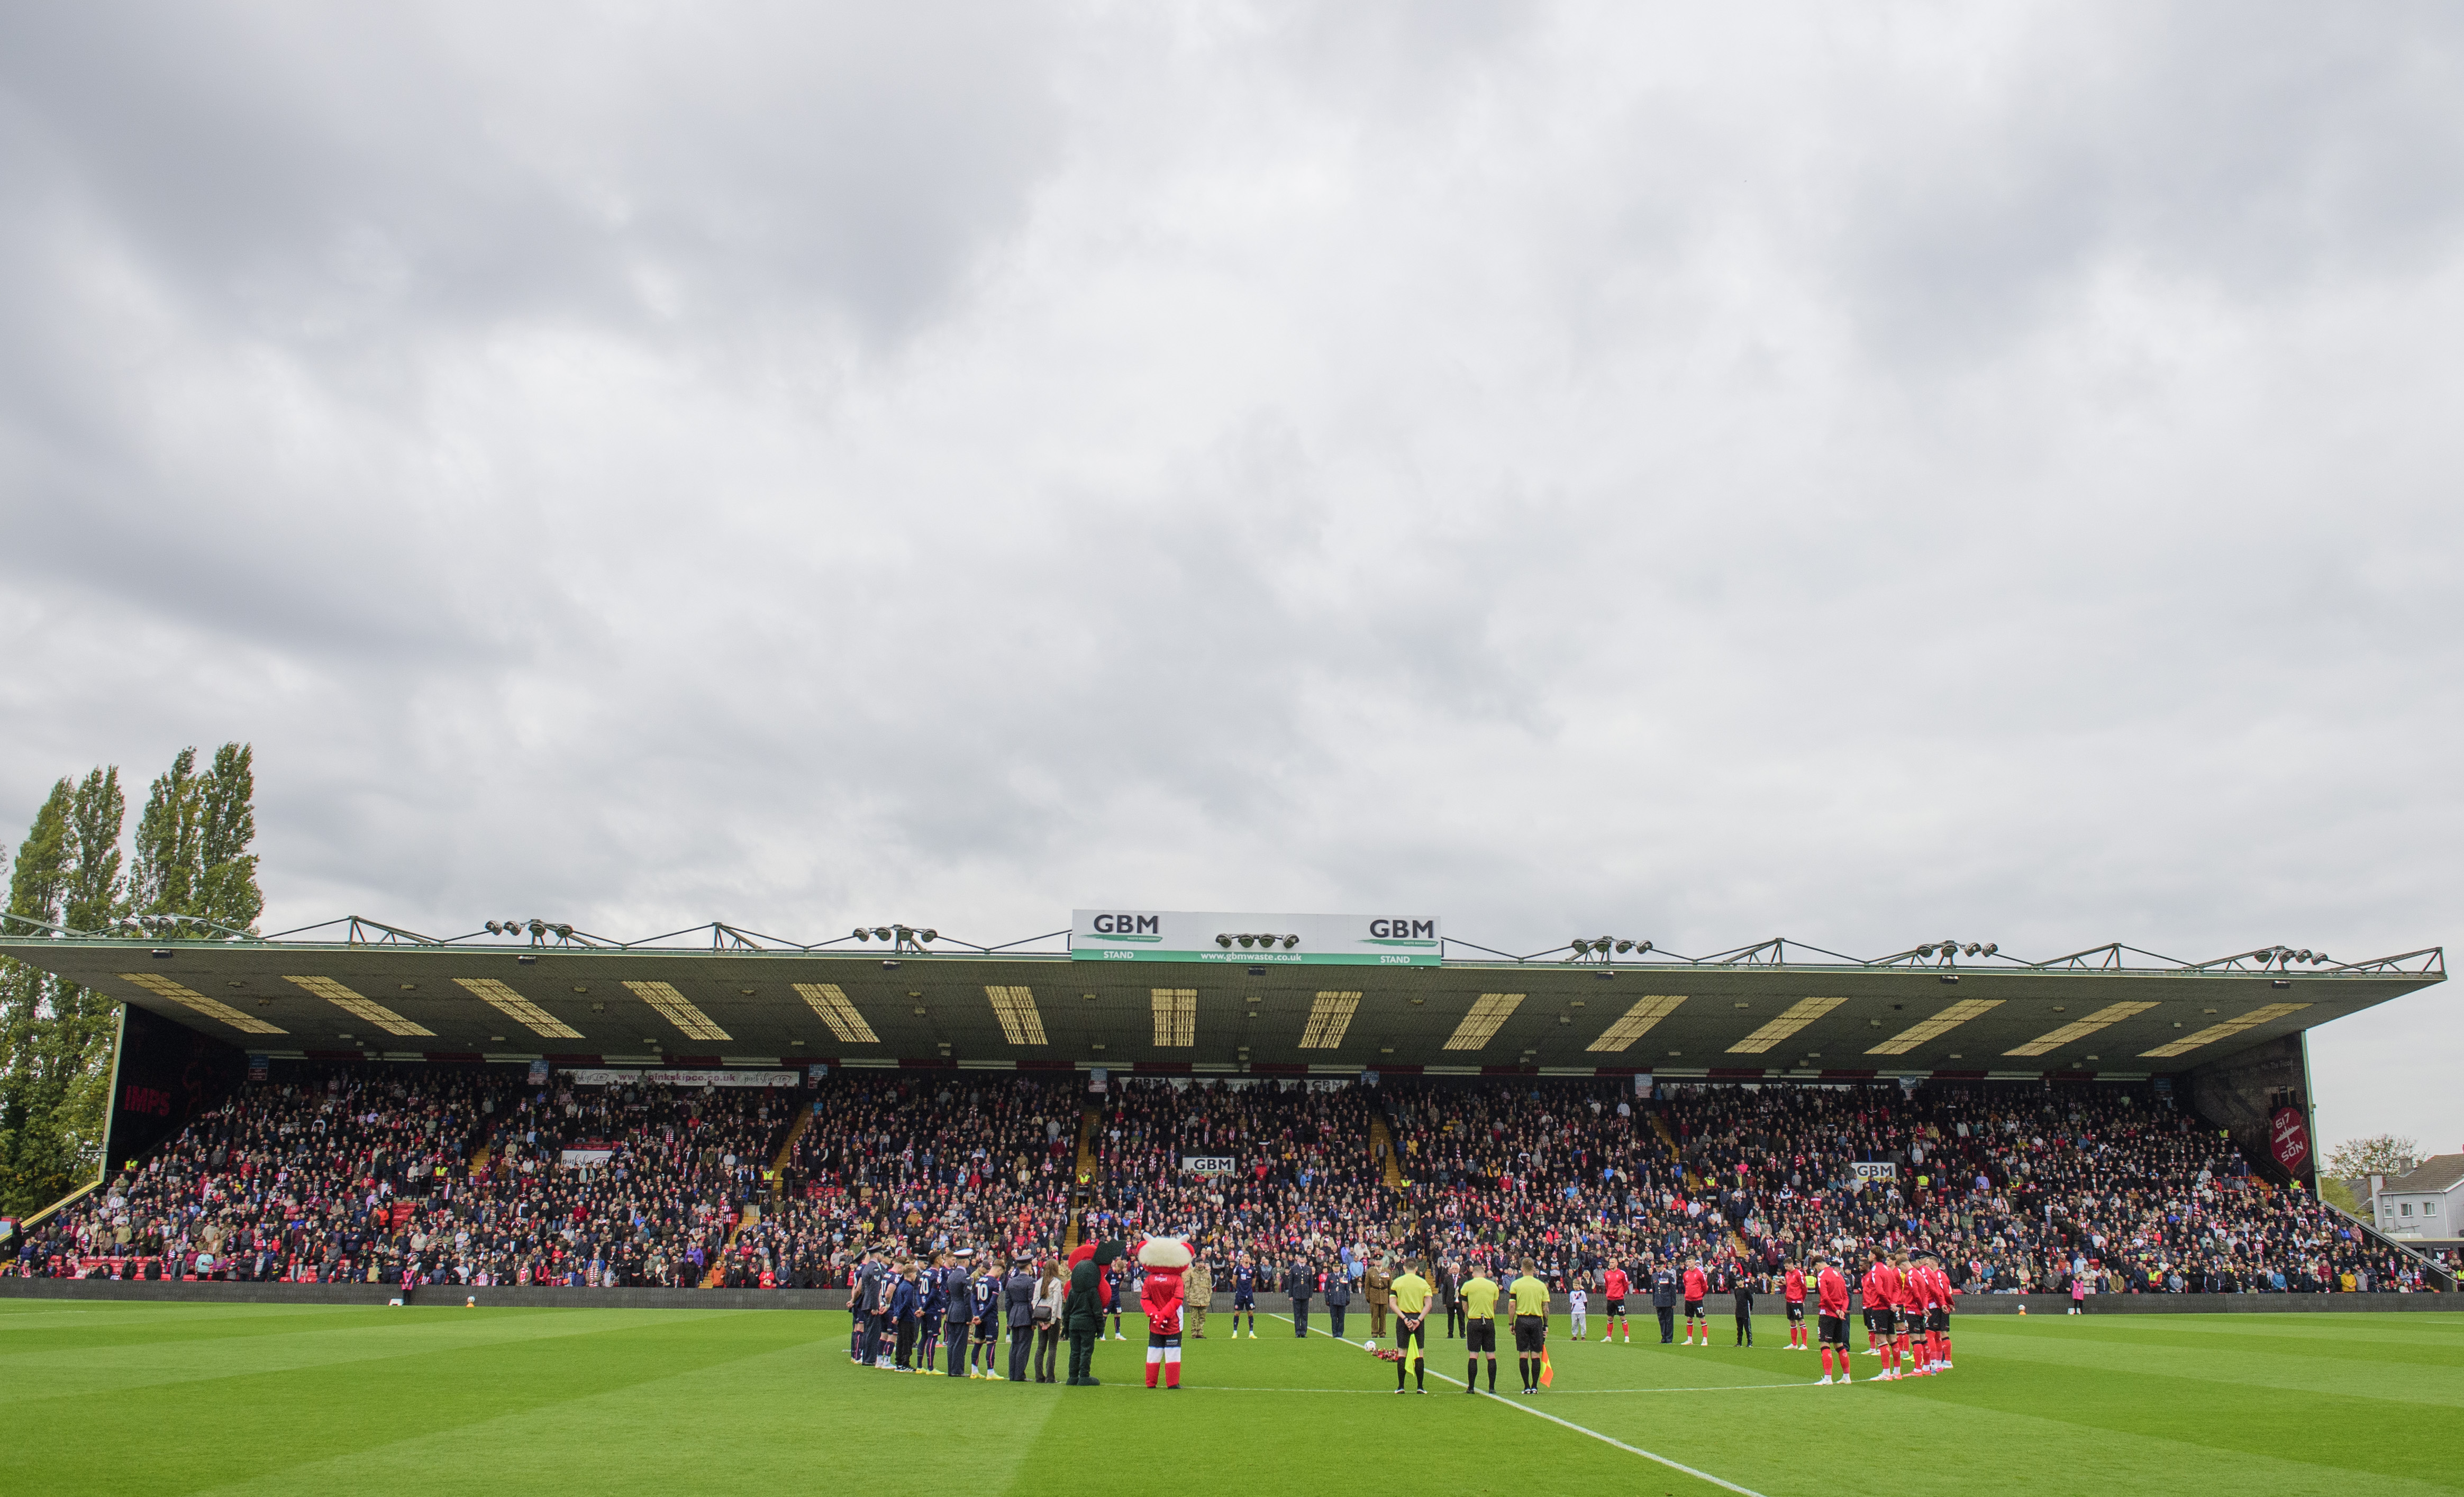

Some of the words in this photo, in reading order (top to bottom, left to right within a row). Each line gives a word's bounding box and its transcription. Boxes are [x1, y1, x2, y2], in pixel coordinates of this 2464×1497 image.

[1094, 914, 1159, 934] GBM
[1370, 919, 1434, 939] GBM
[1201, 952, 1302, 961] www.gbmwaste.co.uk
[123, 1085, 170, 1117] IMPS
[2275, 1112, 2290, 1129] 617
[1194, 1159, 1231, 1170] GBM
[1857, 1165, 1893, 1176] GBM
[919, 1277, 929, 1294] 70
[976, 1283, 988, 1301] 10
